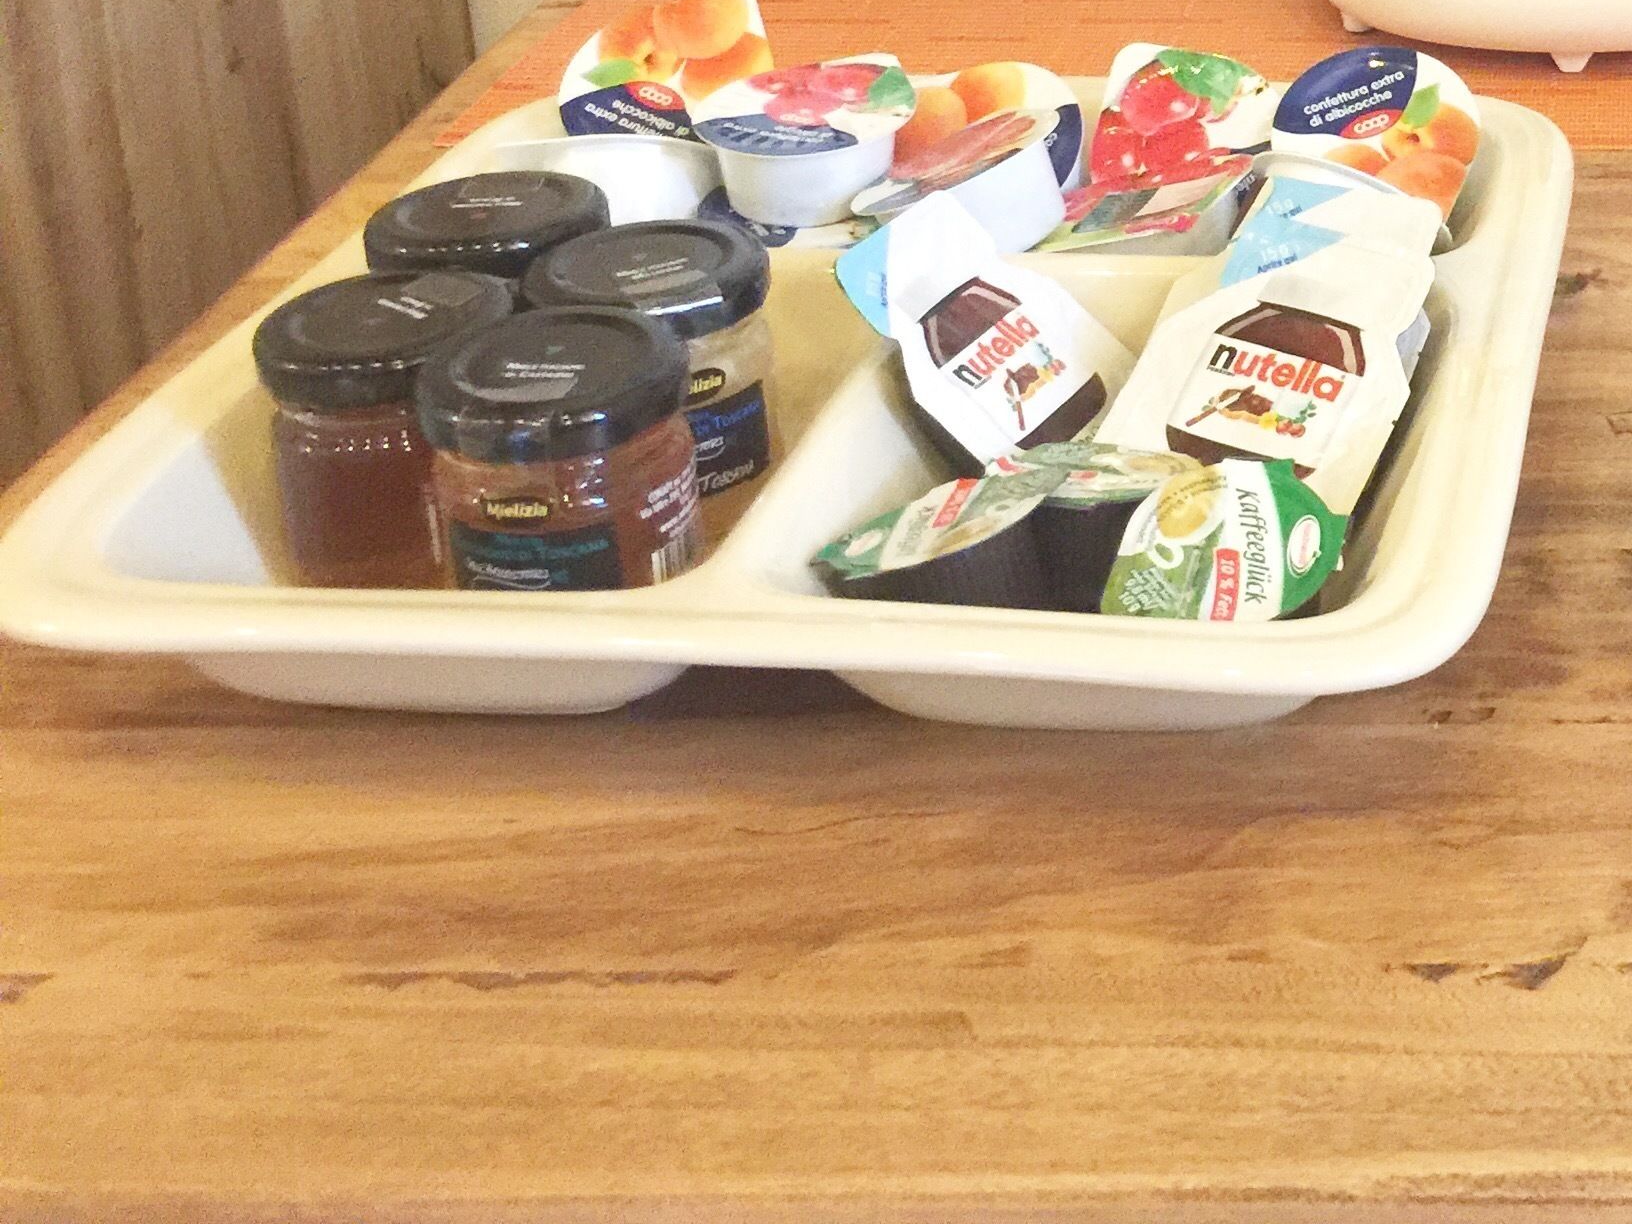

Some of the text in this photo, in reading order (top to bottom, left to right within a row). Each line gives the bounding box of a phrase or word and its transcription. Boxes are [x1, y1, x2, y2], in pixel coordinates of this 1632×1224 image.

[637, 85, 674, 107] coop
[1303, 70, 1405, 115] confettura extra
[1309, 90, 1393, 128] di albicocche
[611, 98, 675, 130] albicocche
[1353, 113, 1390, 135] coop
[952, 315, 1041, 388] nutella
[1199, 343, 1345, 403] nutella
[1235, 488, 1272, 605] Kaffeeglück
[1219, 558, 1235, 575] 10
